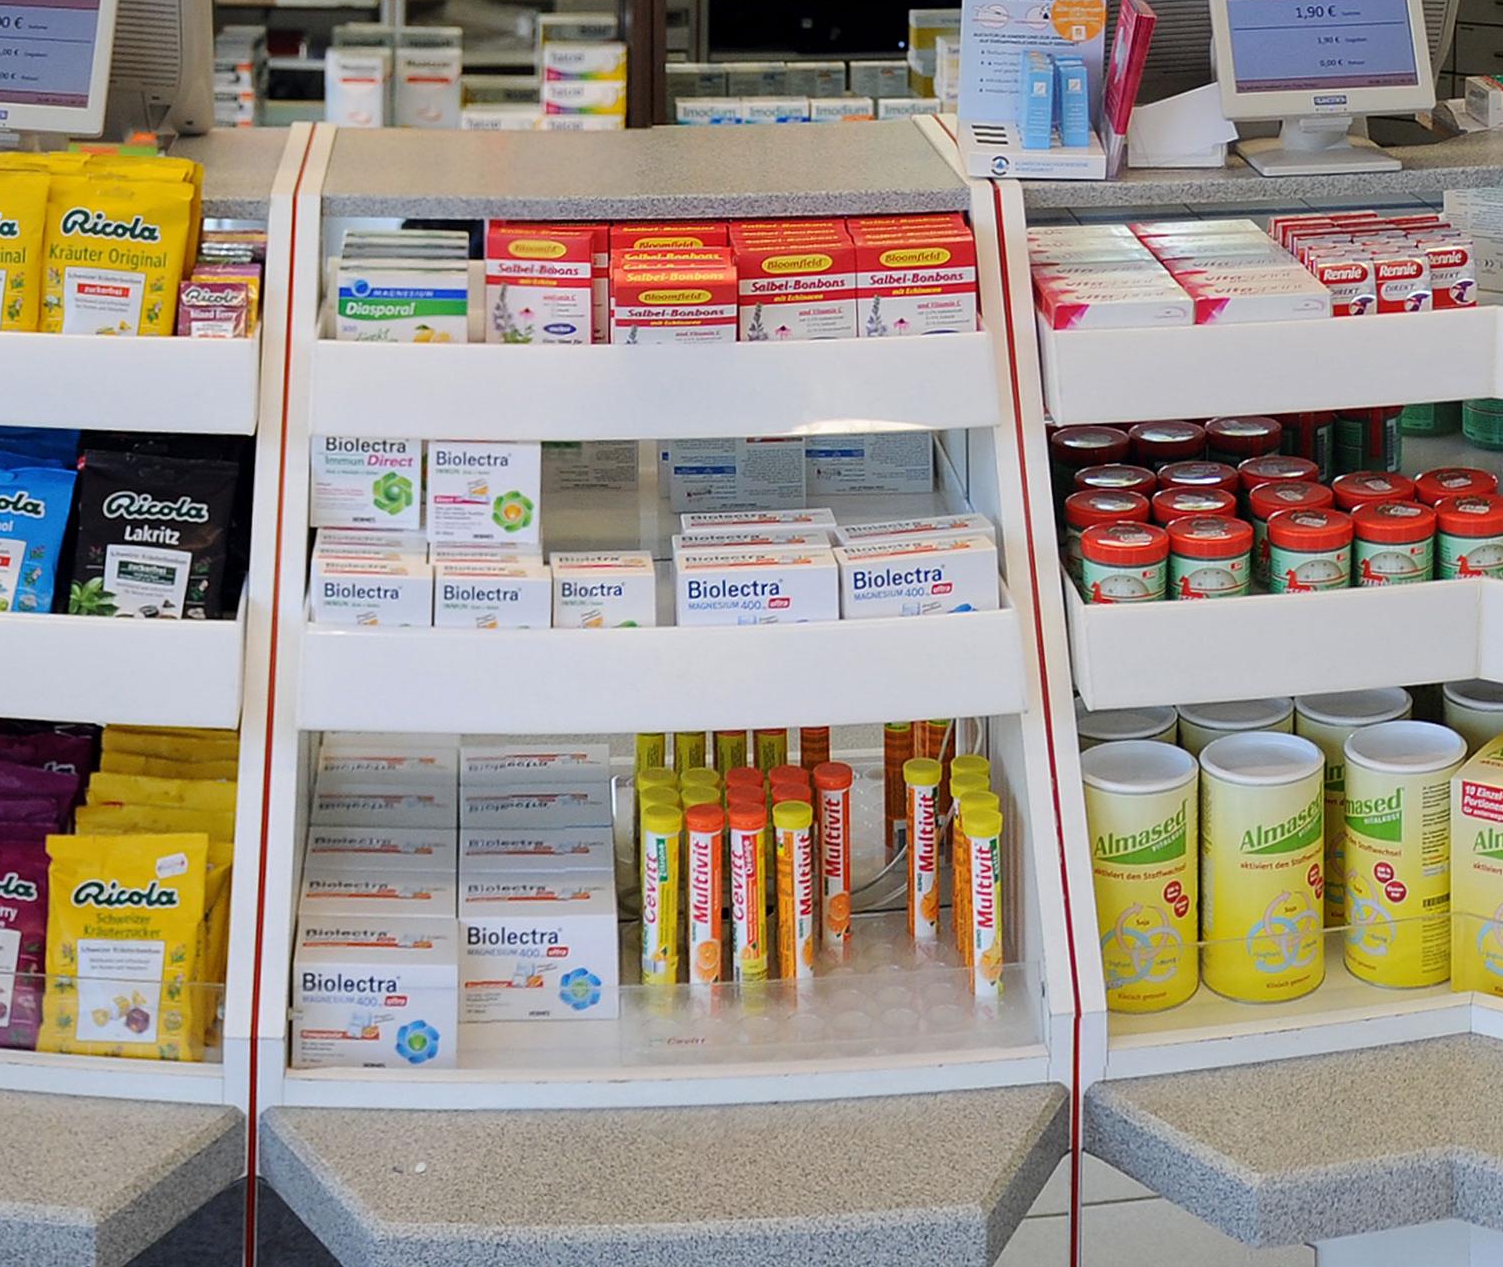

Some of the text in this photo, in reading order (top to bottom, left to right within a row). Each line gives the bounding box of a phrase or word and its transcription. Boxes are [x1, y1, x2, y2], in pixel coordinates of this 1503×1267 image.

[1296, 5, 1336, 19] 1,90 €
[14, 17, 24, 29] €
[49, 243, 167, 270] Kräuter Original
[767, 259, 824, 270] Bloomfield
[885, 251, 942, 263] Bloomfield
[626, 271, 726, 282] Salbei-Bonbons
[870, 271, 964, 285] Salbei-Bonbons
[1323, 267, 1362, 281] Rennie
[1379, 263, 1417, 277] Rennie
[751, 278, 846, 293] Salbei-Bonbons
[1385, 283, 1414, 293] DIREKT
[644, 291, 704, 302] Bloomfield
[346, 301, 415, 317] Diasporal
[627, 307, 725, 319] Salbei-Bonbons
[325, 437, 407, 454] Biolectra
[325, 454, 413, 468] Immun Direct
[436, 451, 509, 467] Biolectra
[124, 525, 180, 546] Lakritz
[853, 568, 942, 589] Biolectra
[324, 583, 400, 600] Biolectra
[443, 585, 520, 602] Biolectra
[688, 580, 780, 600] Biolectra
[919, 794, 936, 872] Multivit
[1094, 799, 1188, 857] Almased
[825, 797, 842, 877] Multivit
[693, 840, 709, 923] Multivit
[798, 833, 811, 916] Multivit
[977, 845, 994, 928] Multivit
